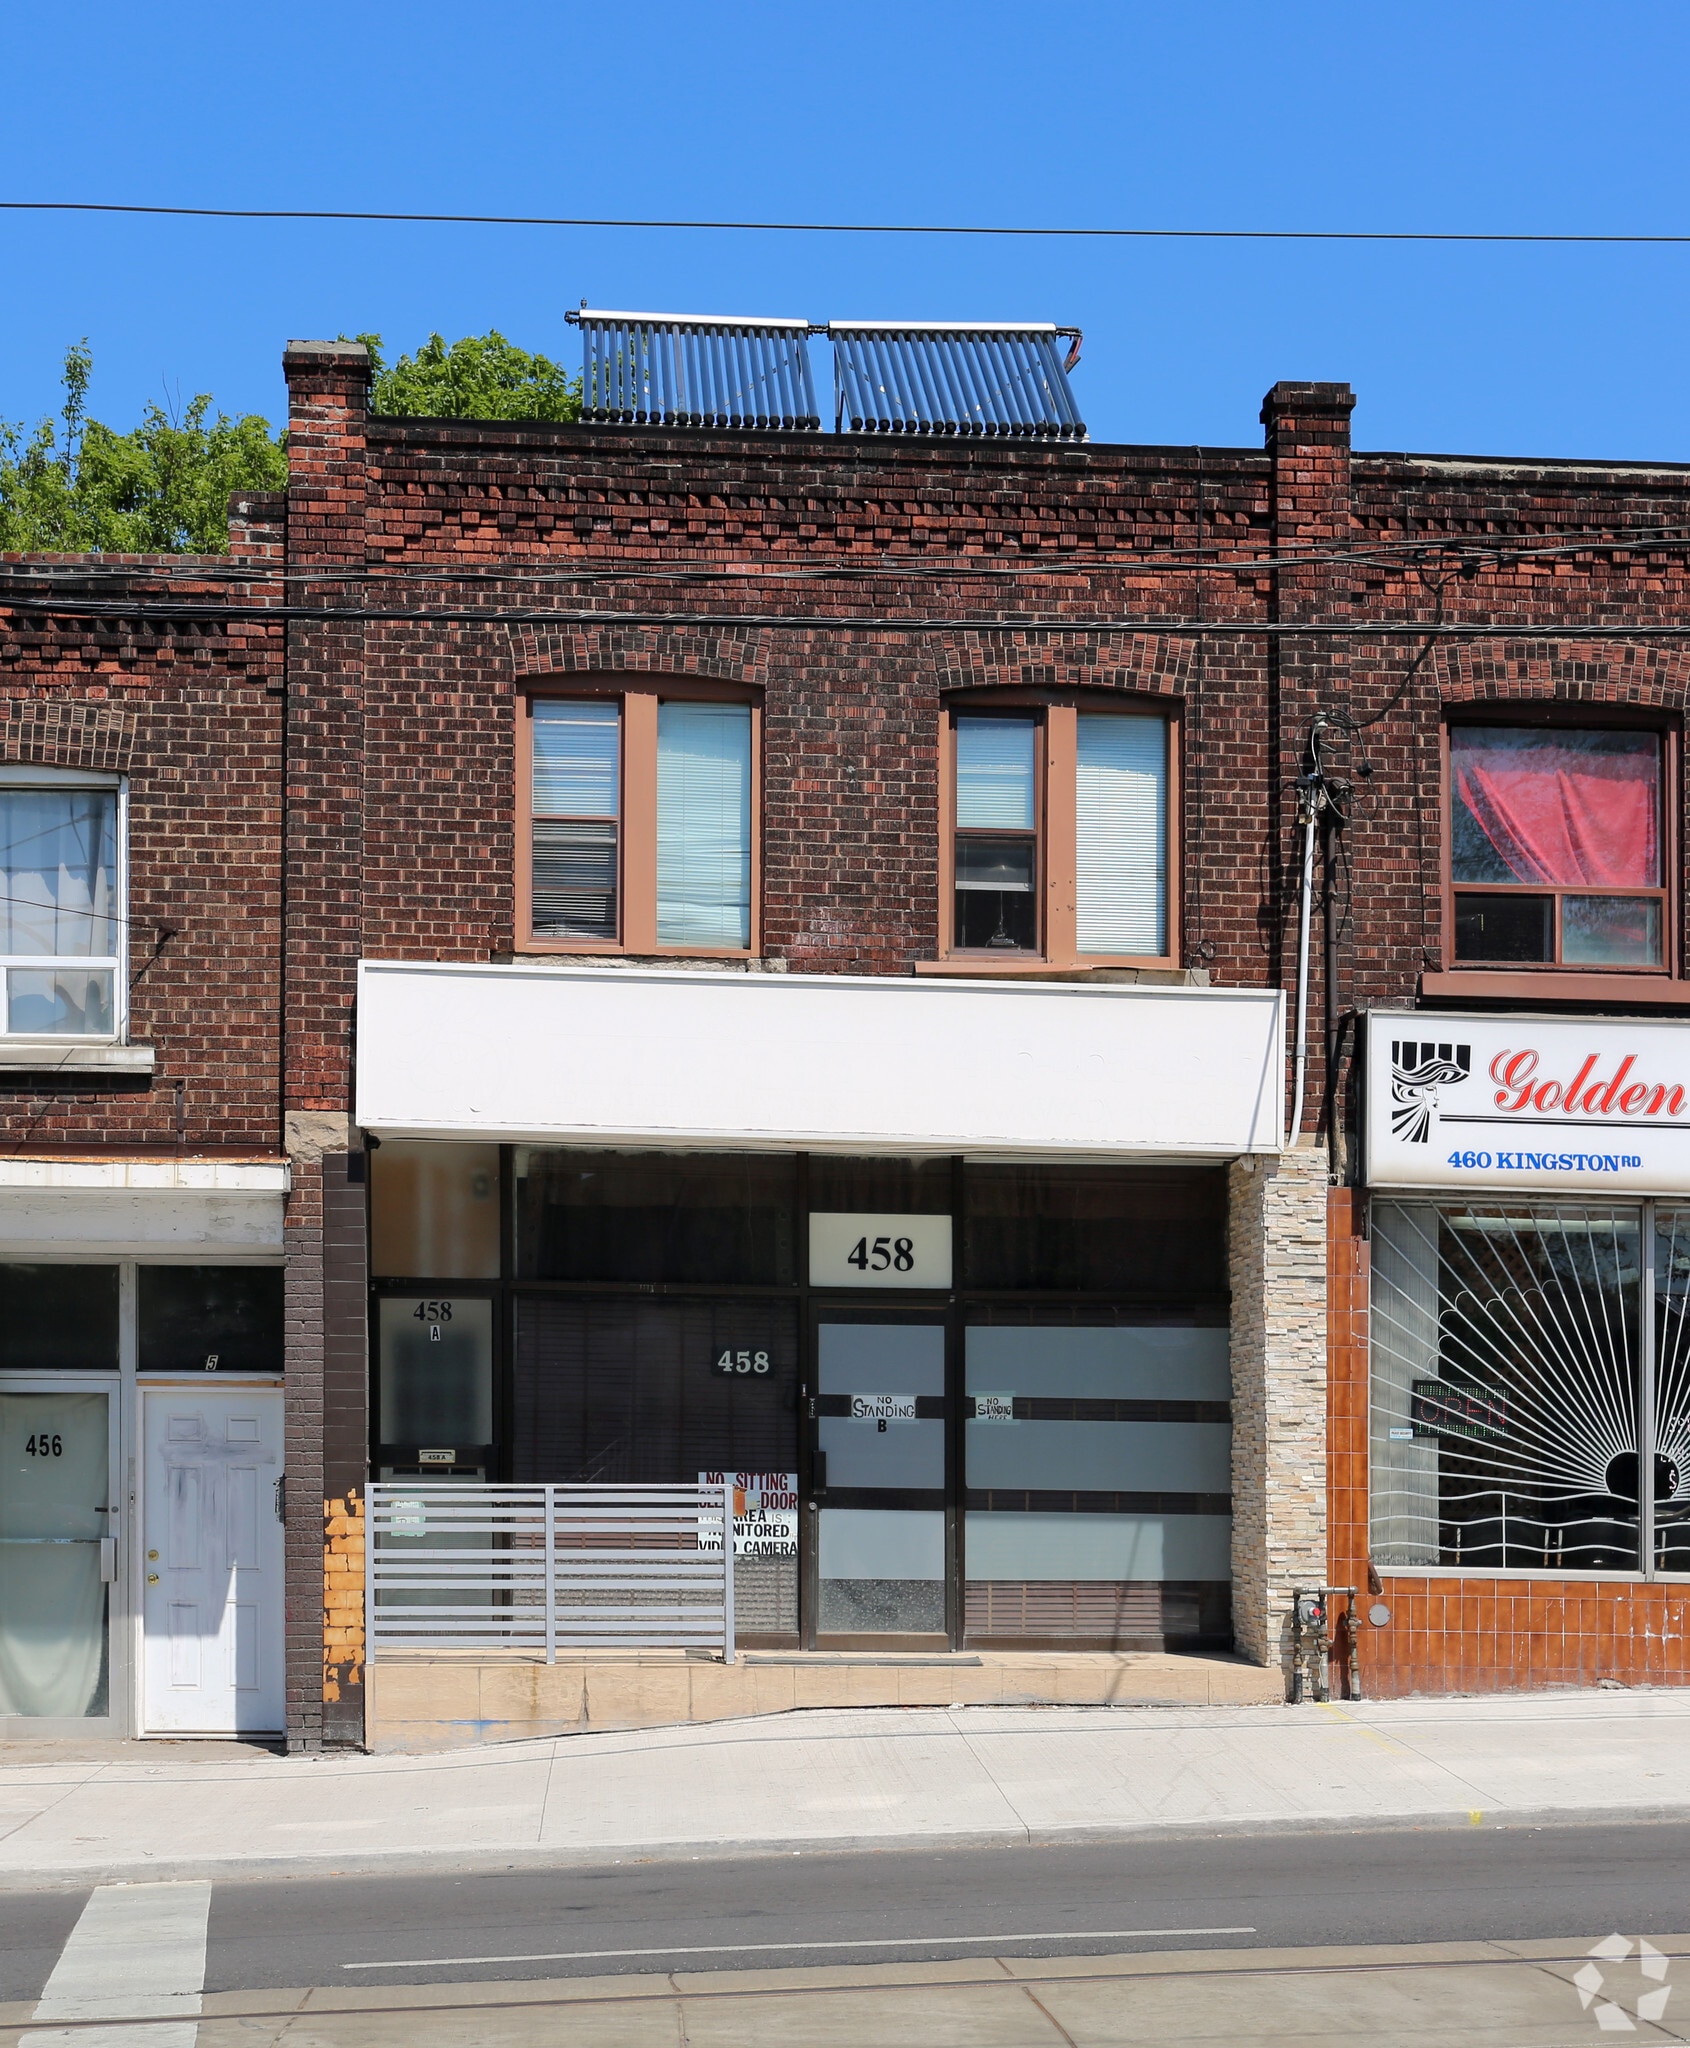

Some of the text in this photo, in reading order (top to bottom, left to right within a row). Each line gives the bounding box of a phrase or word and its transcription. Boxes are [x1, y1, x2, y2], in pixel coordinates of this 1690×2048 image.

[1488, 1048, 1687, 1116] Golden
[1447, 1151, 1492, 1168] 460
[1496, 1152, 1619, 1171] KINGSTON
[847, 1237, 915, 1272] 458
[413, 1301, 452, 1321] 458
[432, 1326, 440, 1340] A
[207, 1356, 217, 1370] 5
[717, 1350, 770, 1373] 458
[877, 1396, 892, 1404] NO
[986, 1397, 999, 1405] NO
[1420, 1396, 1507, 1425] OPEN
[878, 1419, 887, 1432] B
[26, 1434, 62, 1457] 456
[706, 1472, 788, 1491] NO SITTING
[761, 1492, 798, 1510] DOOR
[771, 1513, 782, 1523] IS
[744, 1541, 798, 1555] CAMERA
